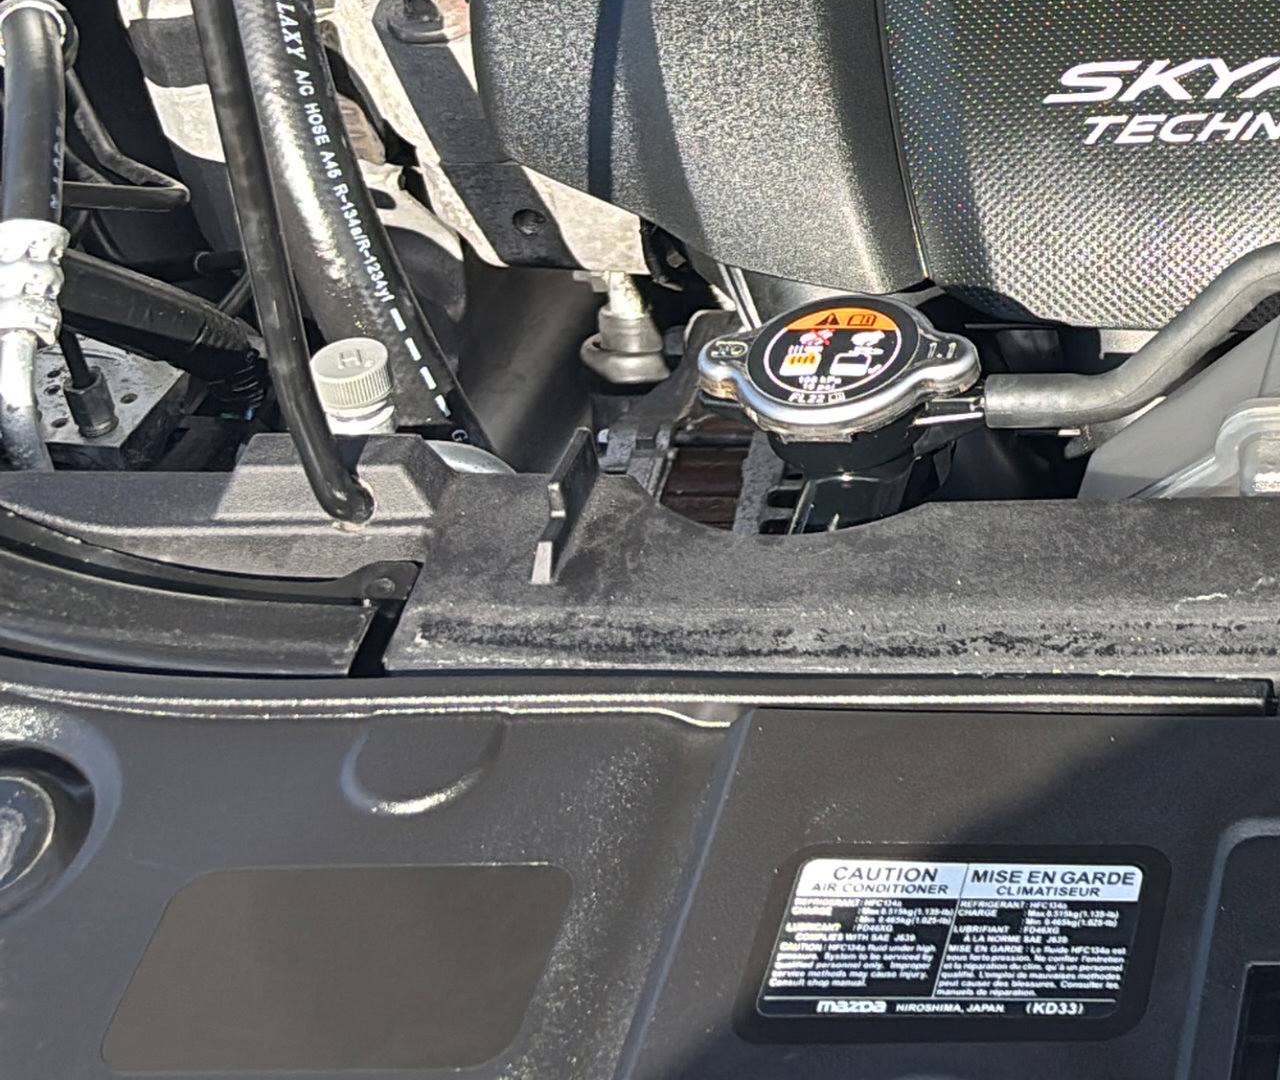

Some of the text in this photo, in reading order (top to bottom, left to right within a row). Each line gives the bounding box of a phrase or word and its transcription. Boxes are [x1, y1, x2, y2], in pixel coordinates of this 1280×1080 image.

[294, 69, 315, 96] A/C
[303, 103, 330, 147] HOSE
[834, 867, 938, 882] CAUTION
[971, 870, 1136, 885] MISE EN GARDE
[812, 883, 948, 894] AIR CONDITIONER
[996, 886, 1101, 897] CLIMATISEUR
[958, 909, 997, 917] CHARGE
[953, 925, 1010, 933] LUBRIFIANT
[846, 933, 869, 942] WITH
[871, 934, 889, 942] SAE
[987, 935, 1021, 943] NORME
[1023, 935, 1042, 943] SAE
[868, 944, 887, 952] fluid
[917, 945, 936, 954] high
[948, 945, 971, 953] MISE
[975, 945, 987, 953] EN
[991, 946, 1023, 954] GARDE
[1044, 946, 1069, 955] fluide
[824, 953, 857, 962] System
[859, 953, 868, 961] to
[870, 953, 881, 961] be
[883, 953, 920, 961] serviced
[923, 954, 933, 963] by
[1048, 955, 1078, 964] confier
[816, 962, 861, 970] personnel
[890, 962, 931, 971] Improper
[1079, 964, 1123, 972] personnel
[772, 970, 805, 978] service
[808, 970, 846, 978] methods
[849, 971, 867, 979] may
[1029, 972, 1076, 980] mauvaises
[769, 979, 804, 987] Consult
[807, 979, 829, 988] shop
[938, 980, 959, 988] peut
[993, 980, 1008, 988] des
[1060, 981, 1103, 989] Consulter
[816, 1001, 886, 1013] mazda
[1026, 1003, 1084, 1015] (KD33)
